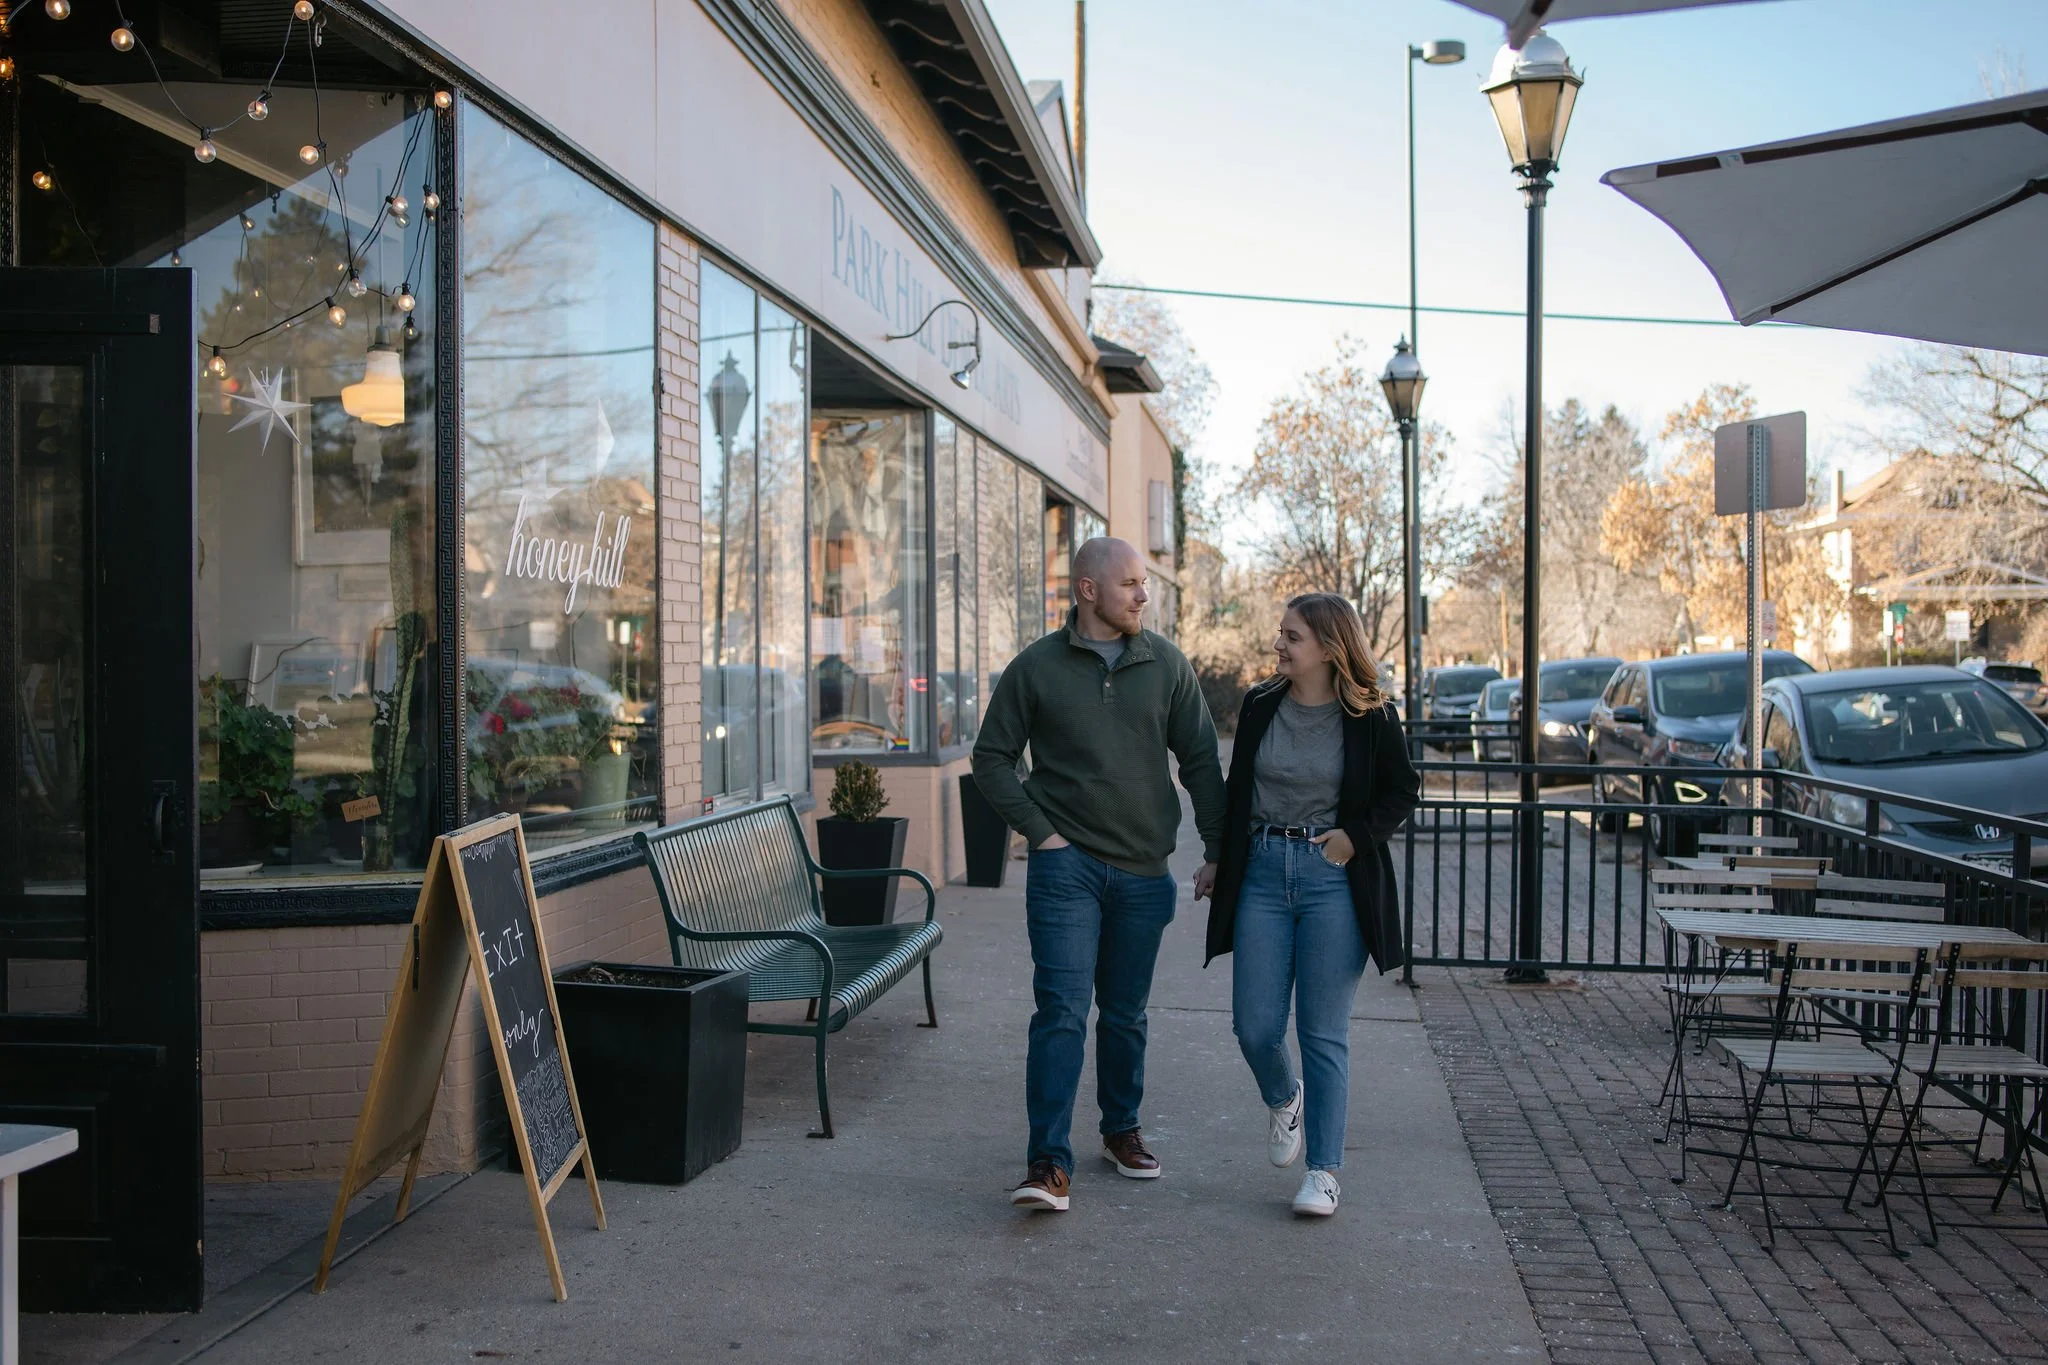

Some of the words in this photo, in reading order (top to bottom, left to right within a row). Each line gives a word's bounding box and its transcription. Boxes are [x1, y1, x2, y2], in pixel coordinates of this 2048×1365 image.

[830, 183, 890, 322] PARK
[895, 248, 936, 357] HILL
[503, 1007, 544, 1059] only
